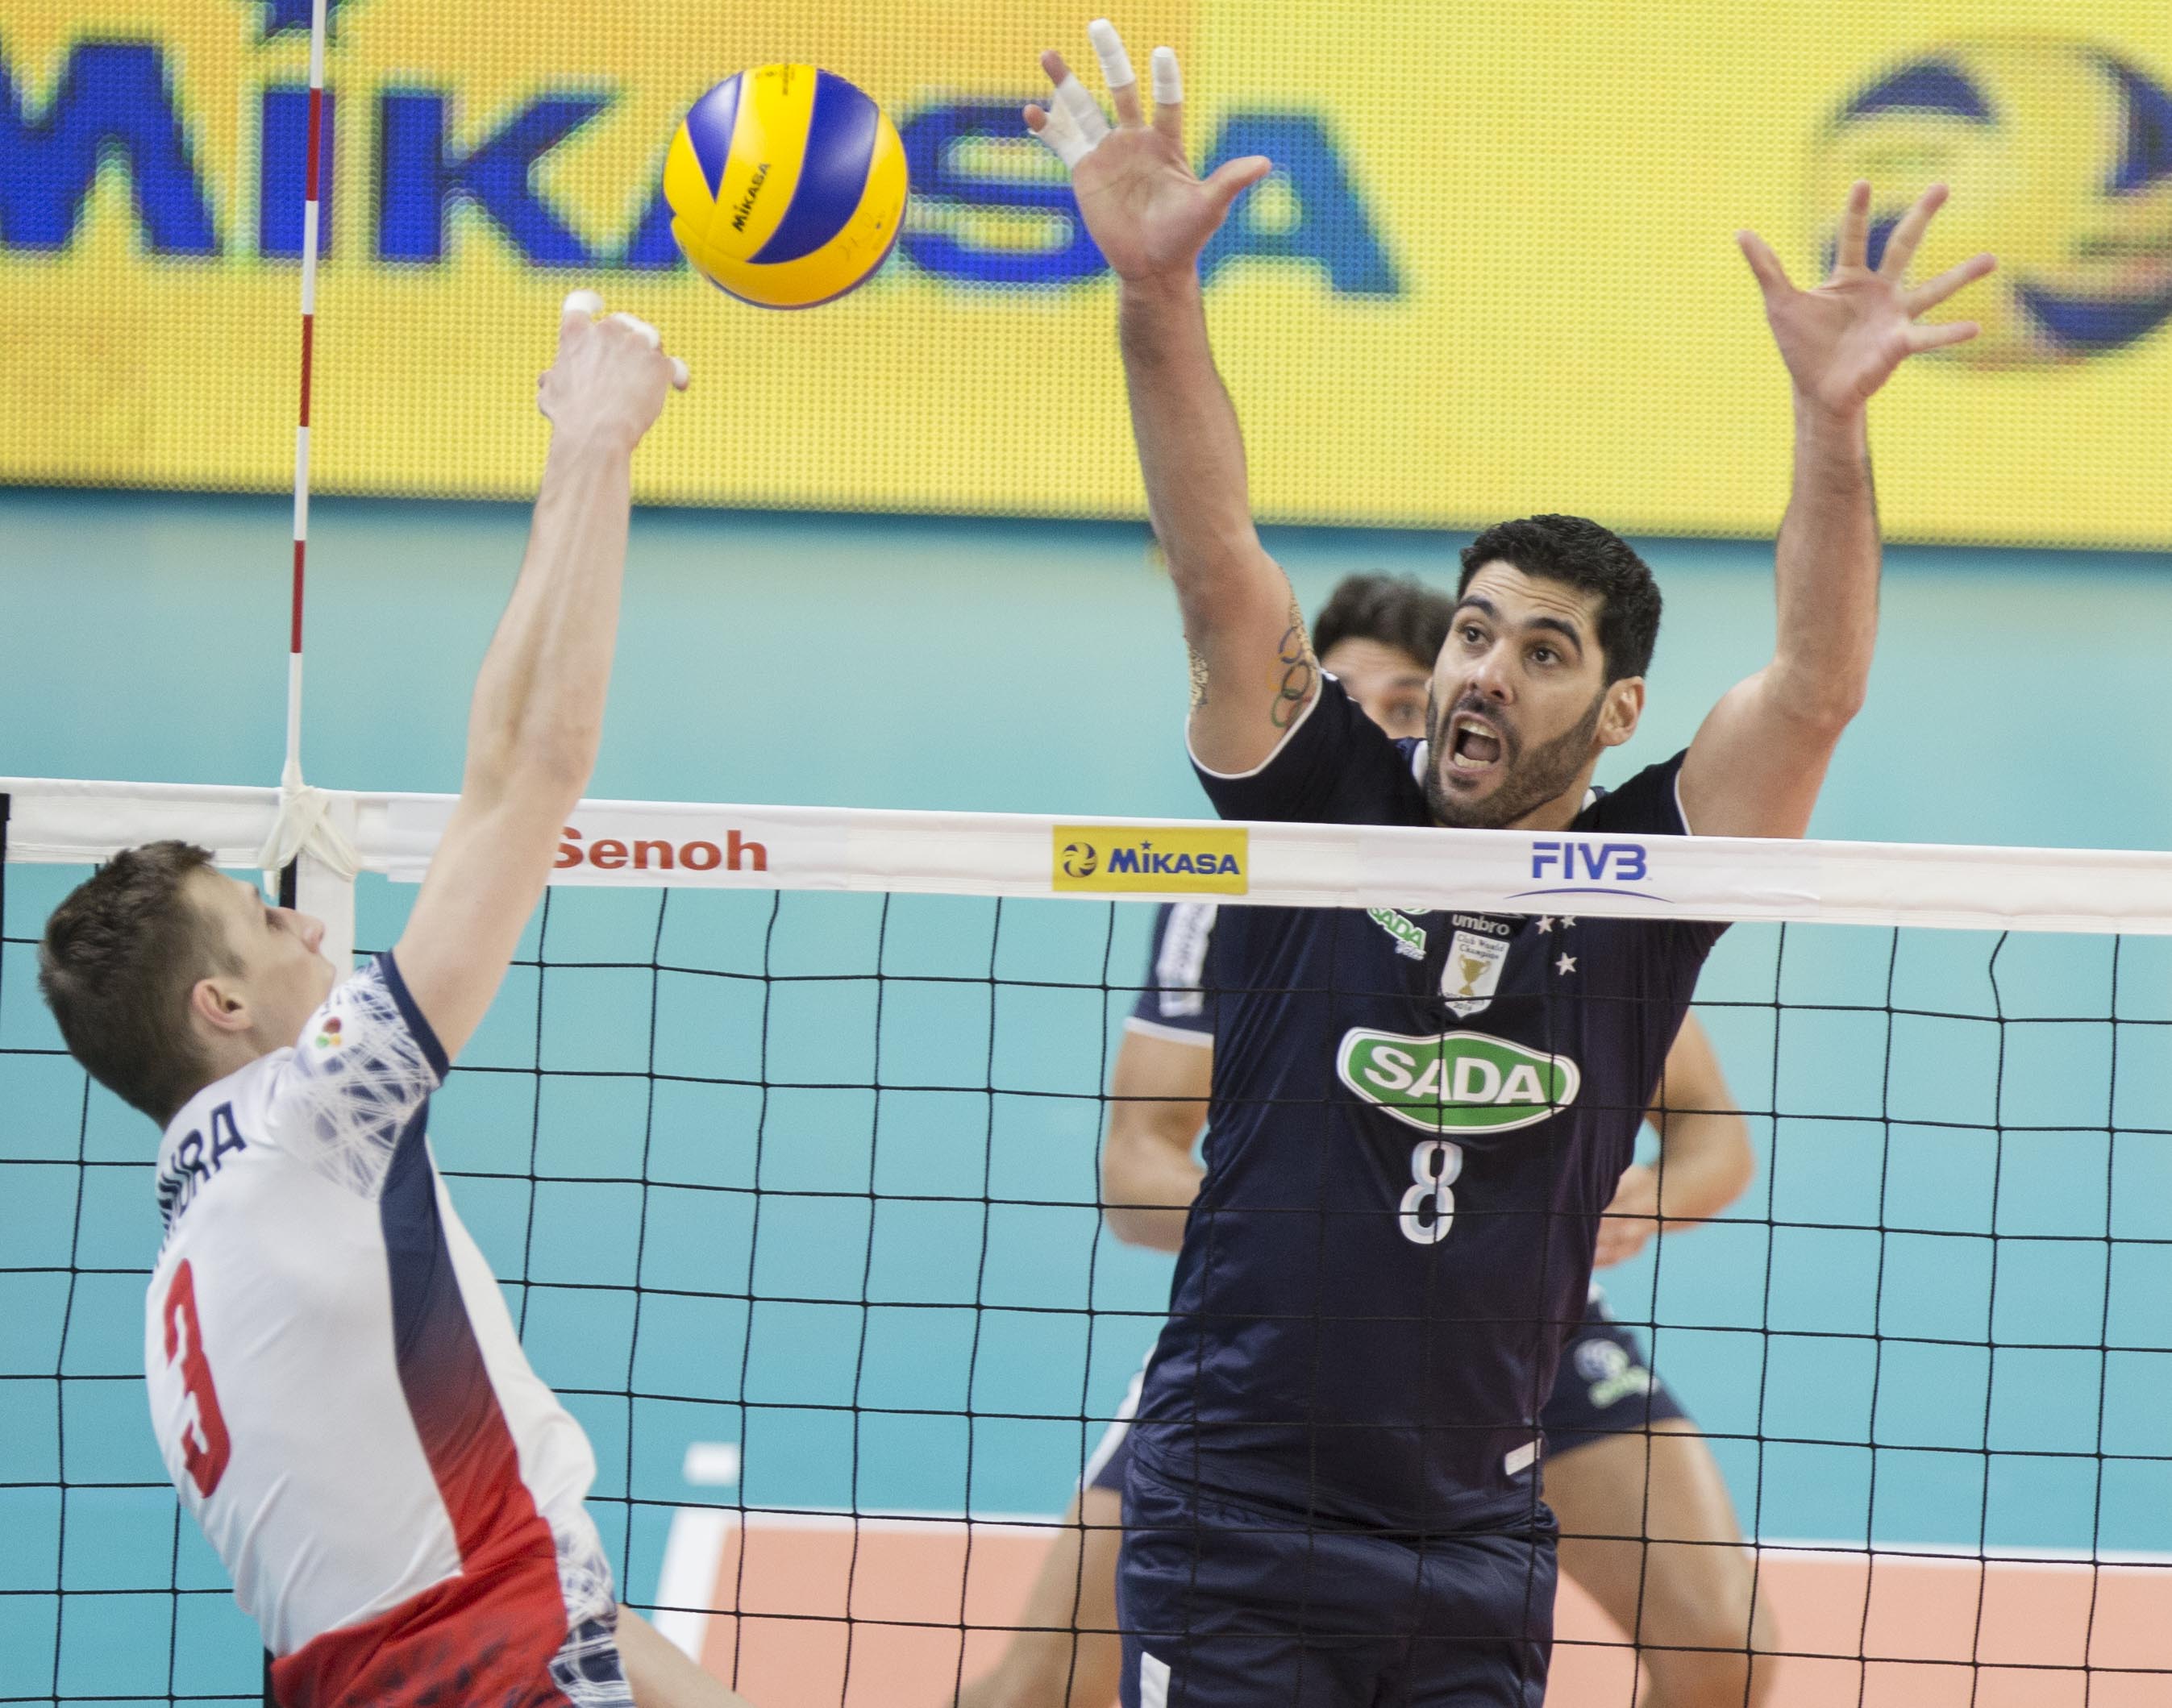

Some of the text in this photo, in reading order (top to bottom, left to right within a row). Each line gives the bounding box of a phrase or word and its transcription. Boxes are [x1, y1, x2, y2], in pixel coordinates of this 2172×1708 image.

[552, 826, 768, 871] Senoh
[1532, 842, 1646, 880] FIVB
[1452, 913, 1510, 936] umbro
[1364, 1045, 1546, 1103] SADA
[1399, 1141, 1463, 1244] 8
[164, 1257, 231, 1498] 3
